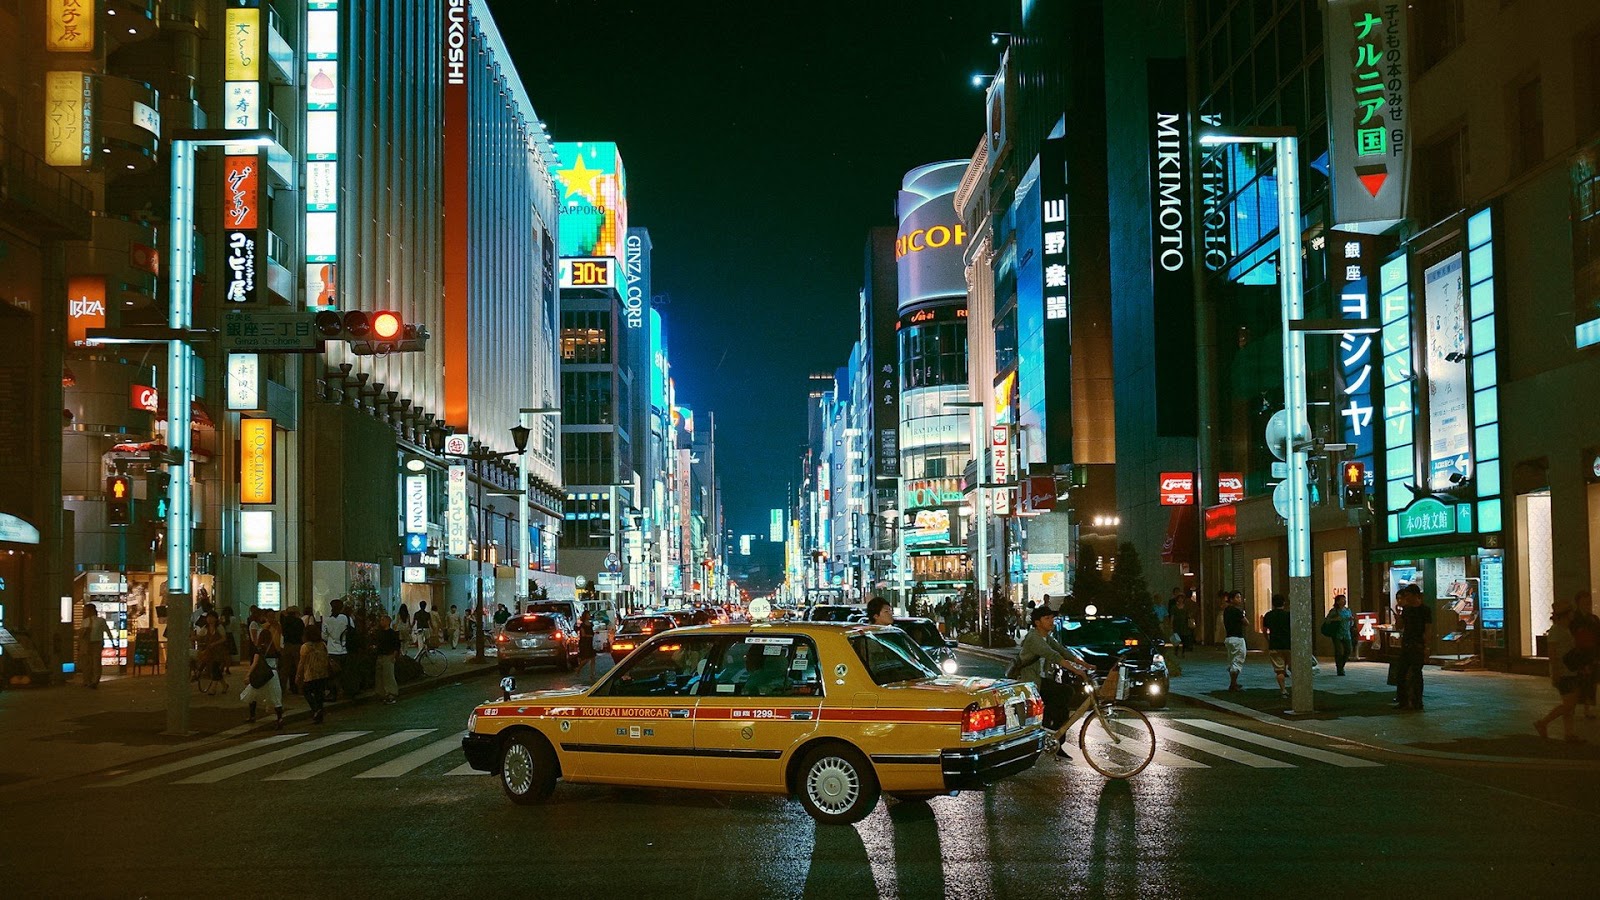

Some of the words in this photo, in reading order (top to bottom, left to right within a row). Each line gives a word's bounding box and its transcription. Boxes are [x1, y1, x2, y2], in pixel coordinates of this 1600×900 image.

[1384, 4, 1403, 121] 子どもの本のみせ
[1353, 12, 1387, 158] ナルニア国
[66, 100, 78, 139] マリア
[236, 98, 250, 127] 寿司
[51, 100, 64, 155] アマリア
[1391, 129, 1404, 157] 6F
[1157, 112, 1184, 272] MIKIMOTO
[227, 232, 247, 302] コーヒー屋
[627, 235, 642, 284] GINZA
[1044, 199, 1068, 320] 山野楽器
[1344, 242, 1361, 281] 銀座
[69, 296, 105, 318] IBIZA
[225, 313, 252, 322] 中央区
[628, 286, 643, 329] CORE
[226, 322, 309, 336] 銀座三丁目
[235, 337, 258, 345] Ginza
[1340, 293, 1374, 436] ヨシノヤ
[255, 426, 267, 498] L'OCCITANE
[996, 492, 1006, 510] パン
[1460, 506, 1471, 518] 本
[1405, 510, 1449, 533] 本の教文館
[1486, 535, 1498, 547] 本
[1358, 615, 1377, 640] 本
[543, 708, 576, 716] TAXI
[582, 708, 620, 717] KOKUSAI
[622, 708, 669, 717] MOTORCAR
[753, 709, 773, 718] 1299
